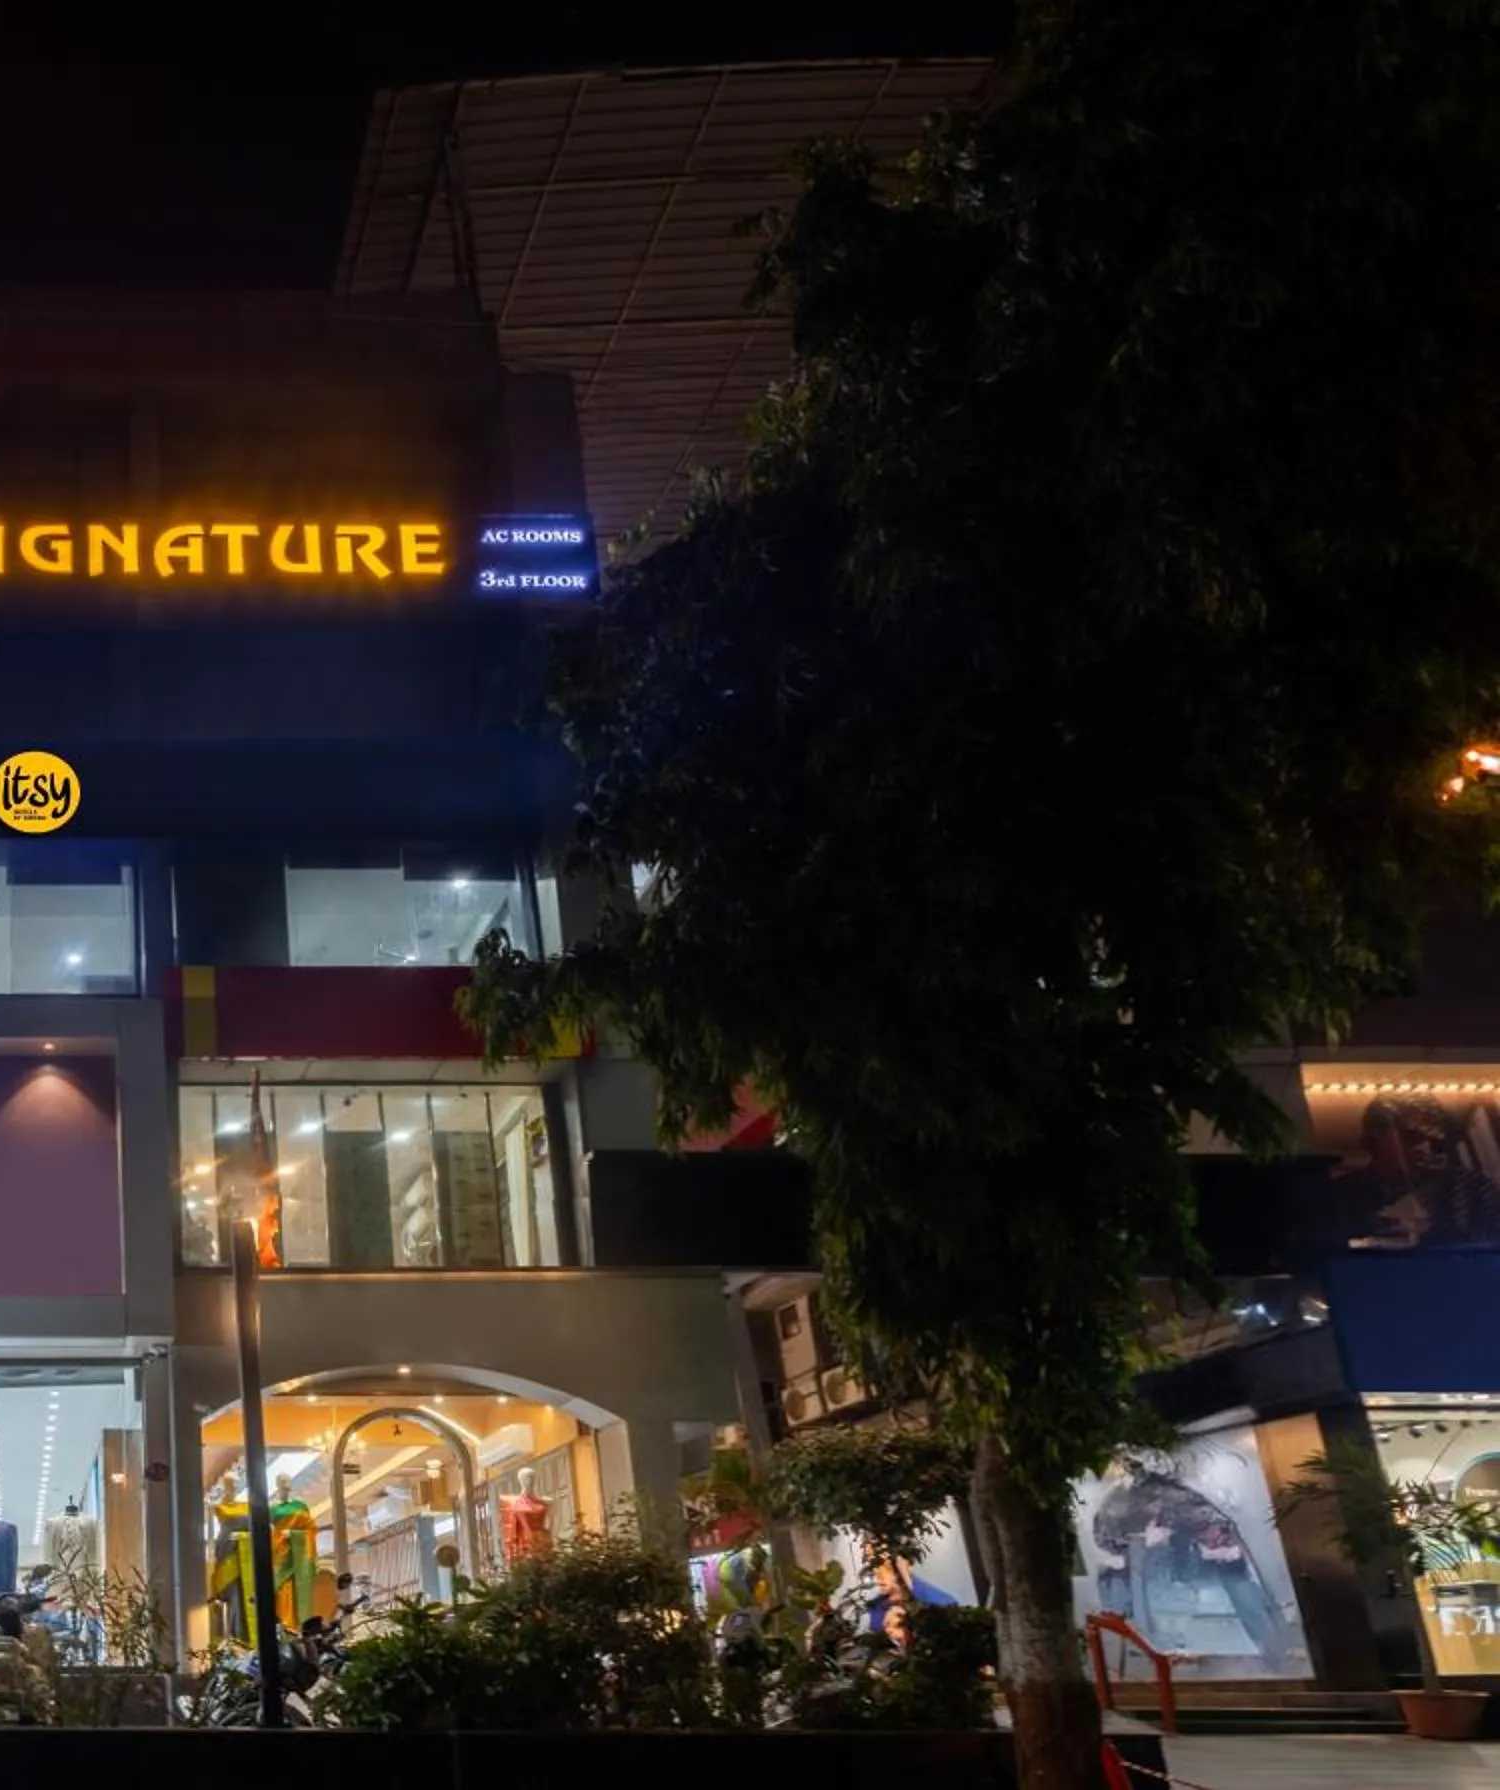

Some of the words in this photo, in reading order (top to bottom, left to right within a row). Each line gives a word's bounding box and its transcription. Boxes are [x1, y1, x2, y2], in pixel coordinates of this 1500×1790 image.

[481, 528, 509, 543] AC
[511, 528, 583, 543] ROOMS
[480, 569, 516, 587] 3rd
[520, 575, 587, 588] FLOOR
[2, 765, 71, 819] itsy
